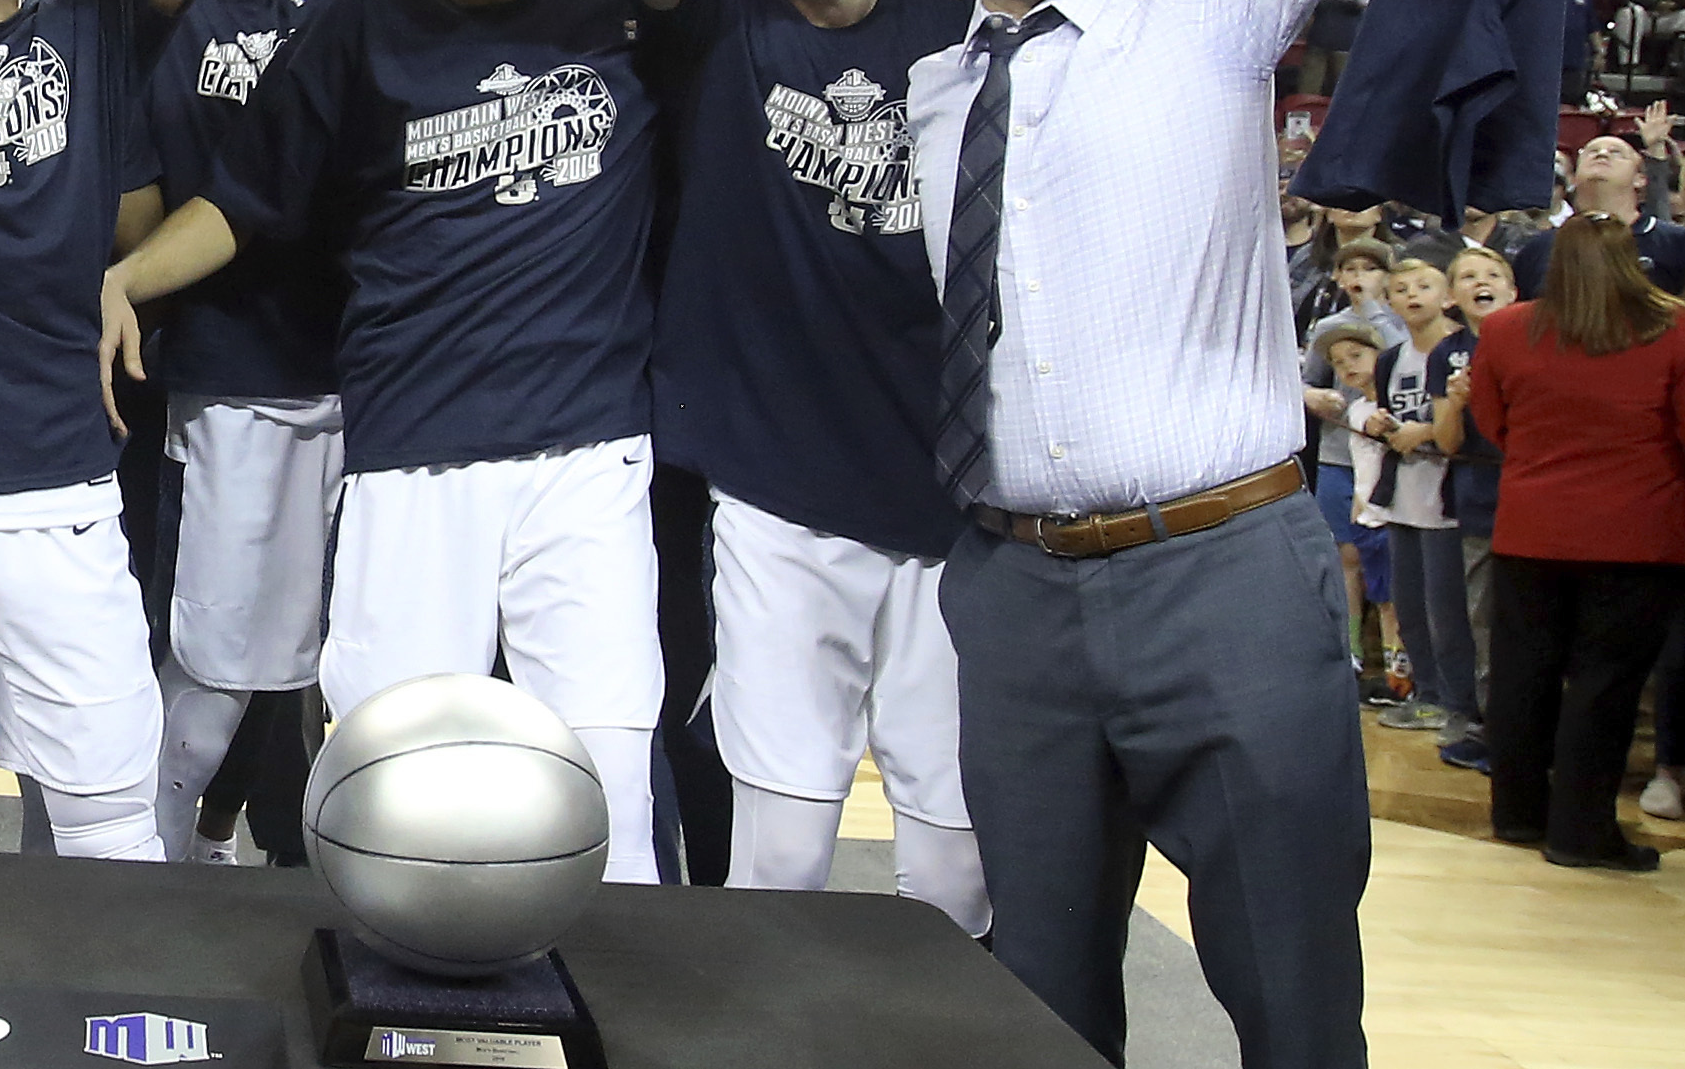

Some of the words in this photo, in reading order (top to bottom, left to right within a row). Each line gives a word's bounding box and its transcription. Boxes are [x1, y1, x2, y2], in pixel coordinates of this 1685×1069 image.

[408, 100, 500, 141] MOUNTAIN
[505, 89, 548, 116] WEST
[847, 120, 896, 144] WEST
[27, 121, 67, 160] 2019
[407, 137, 451, 160] MEN'S
[454, 112, 535, 148] BASKETBALL
[408, 113, 606, 189] CHAMPIONS
[556, 153, 601, 183] 2019
[883, 202, 922, 231] 201
[406, 1042, 436, 1056] WEST
